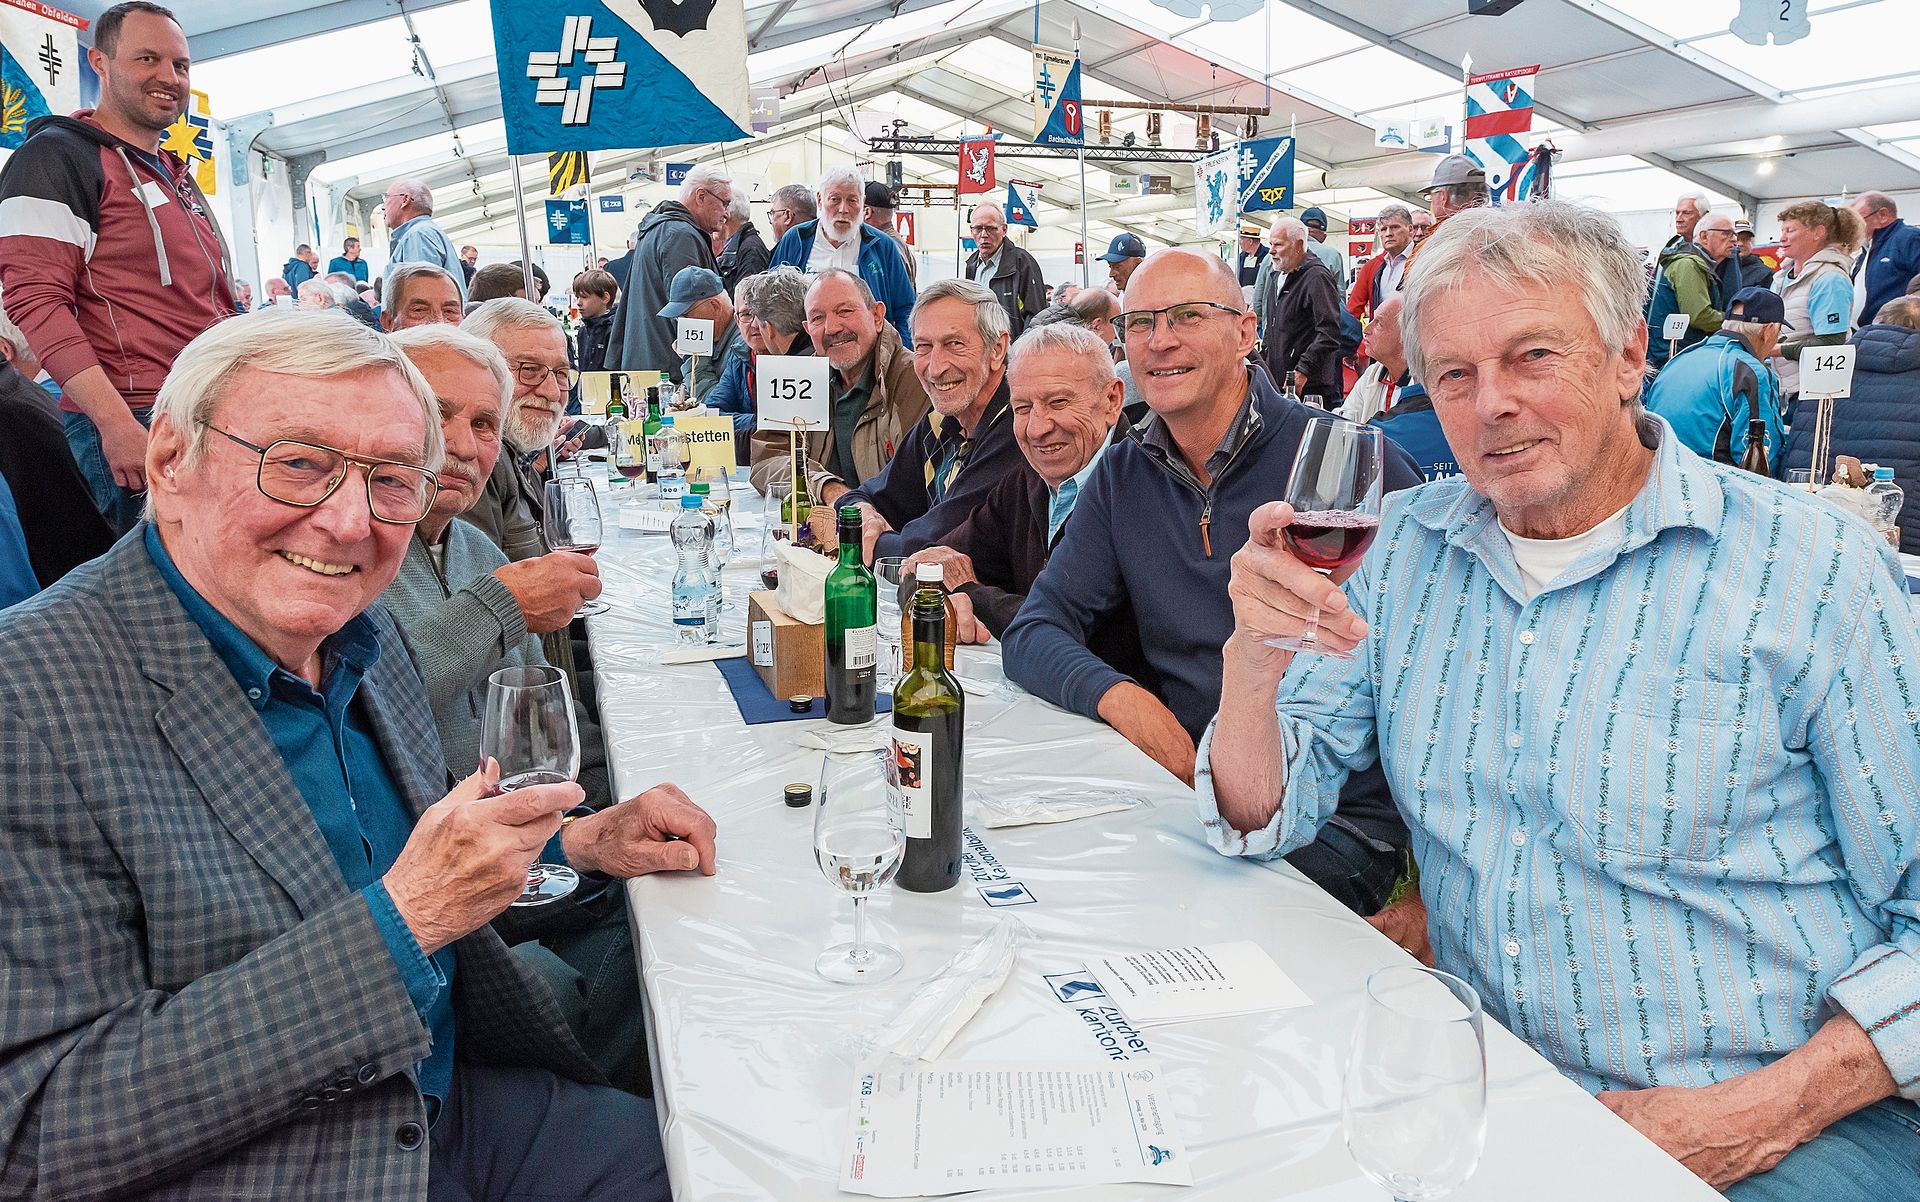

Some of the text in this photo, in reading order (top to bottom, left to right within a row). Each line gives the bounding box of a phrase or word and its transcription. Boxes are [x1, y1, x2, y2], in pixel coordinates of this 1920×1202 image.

[41, 5, 79, 25] Obfelden
[1780, 0, 1791, 21] 2
[881, 125, 890, 138] 5
[752, 183, 759, 192] 7
[1671, 321, 1684, 330] 131
[684, 329, 704, 341] 151
[1814, 355, 1846, 371] 142
[770, 378, 812, 400] 152
[1433, 462, 1453, 471] SEIT
[860, 1081, 874, 1096] ZKB
